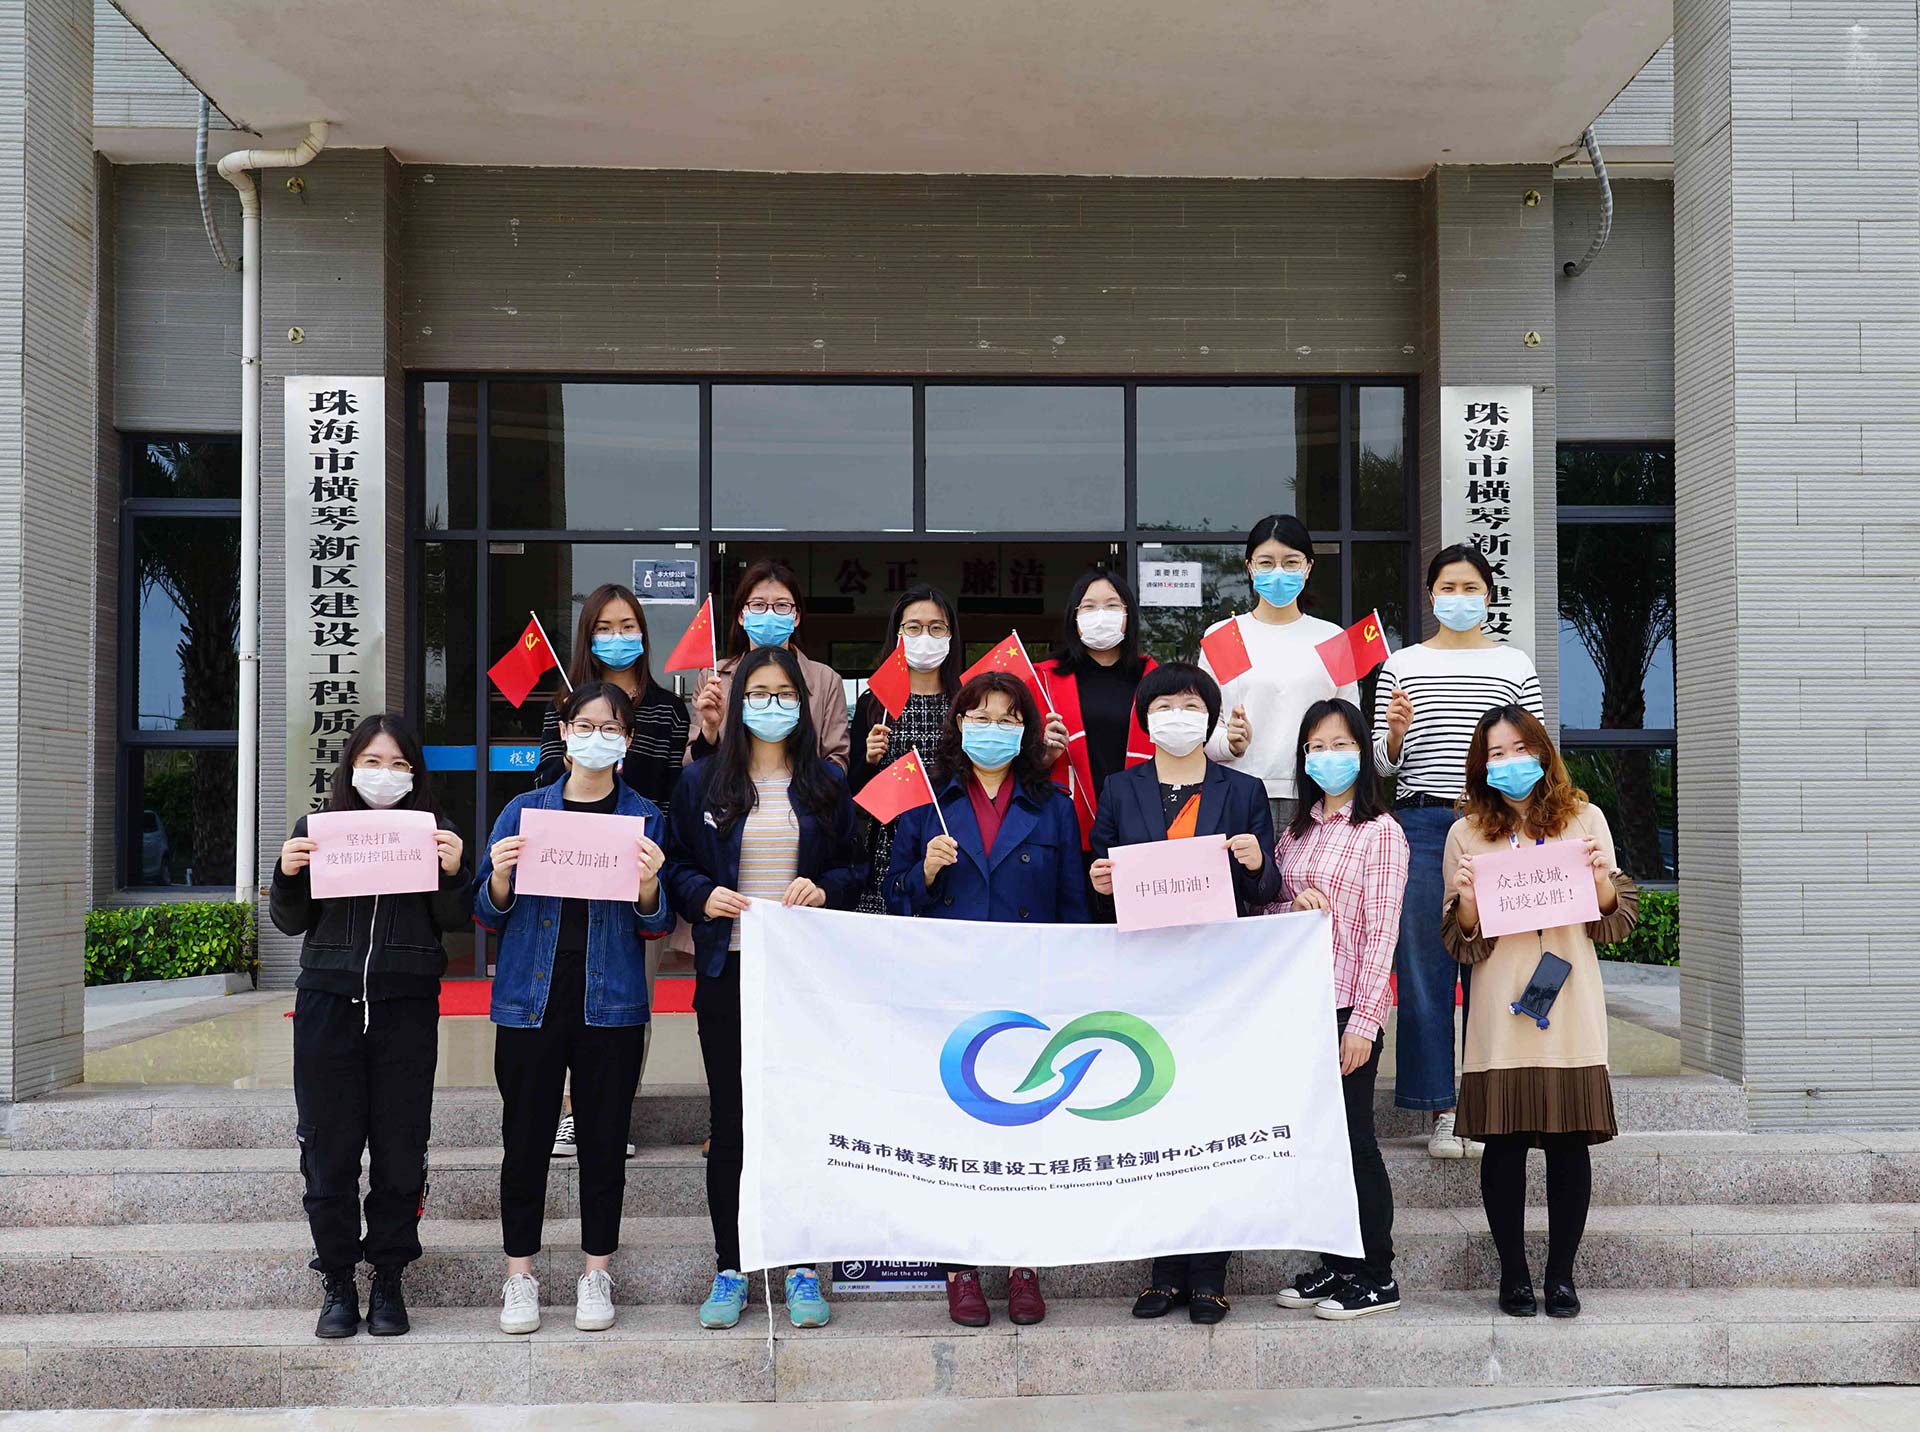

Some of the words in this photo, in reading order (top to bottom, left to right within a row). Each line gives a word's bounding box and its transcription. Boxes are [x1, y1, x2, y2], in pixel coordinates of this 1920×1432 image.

[834, 558, 922, 594] 公正
[960, 558, 1046, 596] 廉洁
[309, 389, 360, 812] 珠海市横琴新区建设工程质量
[346, 831, 401, 847] 坚决打赢
[326, 848, 422, 865] 疫情防控阻击战
[540, 847, 618, 869] 武汉加油！
[1135, 875, 1210, 898] 中国加油！
[1498, 888, 1574, 912] 抗疫必胜！
[828, 1124, 1292, 1176] 珠海市横琴新区建设工程质量检测中心有限公司
[827, 1157, 864, 1170] Zhuhai
[866, 1163, 910, 1179] Hengqin
[912, 1174, 936, 1185] New
[938, 1179, 976, 1191] District
[979, 1183, 1047, 1193] Construction
[1049, 1180, 1113, 1190] Engineering
[1115, 1173, 1153, 1185] Quality
[1155, 1164, 1210, 1178] Inspection
[1212, 1157, 1247, 1169] Center
[913, 1270, 929, 1278] step
